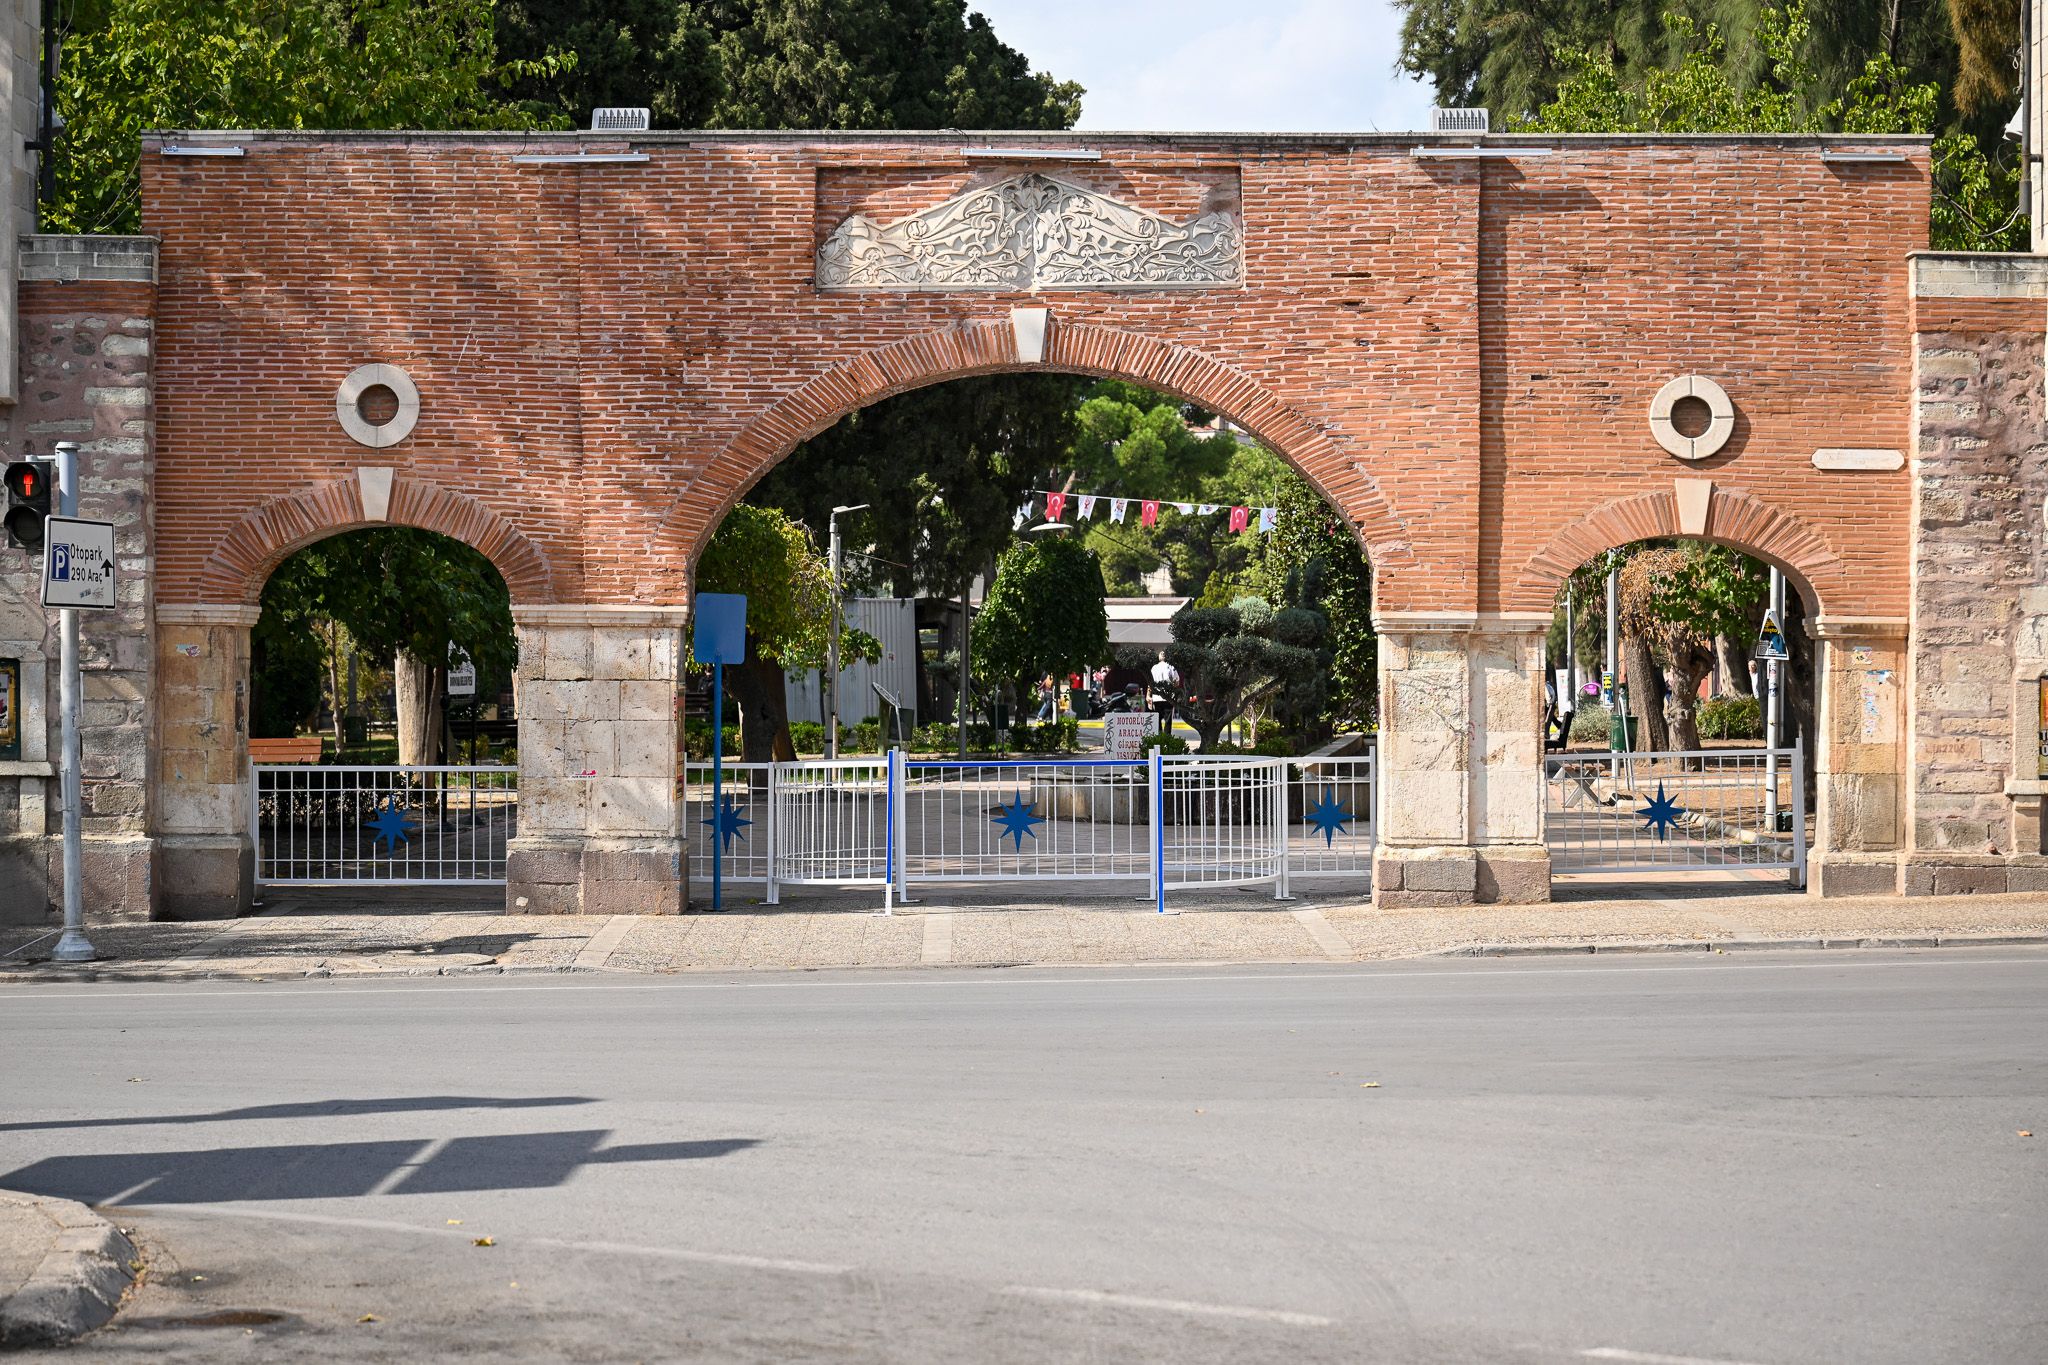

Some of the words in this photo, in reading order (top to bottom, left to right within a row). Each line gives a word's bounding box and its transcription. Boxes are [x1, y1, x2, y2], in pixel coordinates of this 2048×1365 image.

[70, 543, 103, 564] Otopark
[56, 550, 66, 578] P
[71, 567, 86, 581] 290
[87, 568, 103, 584] Araç
[1117, 717, 1145, 725] MOTORLU
